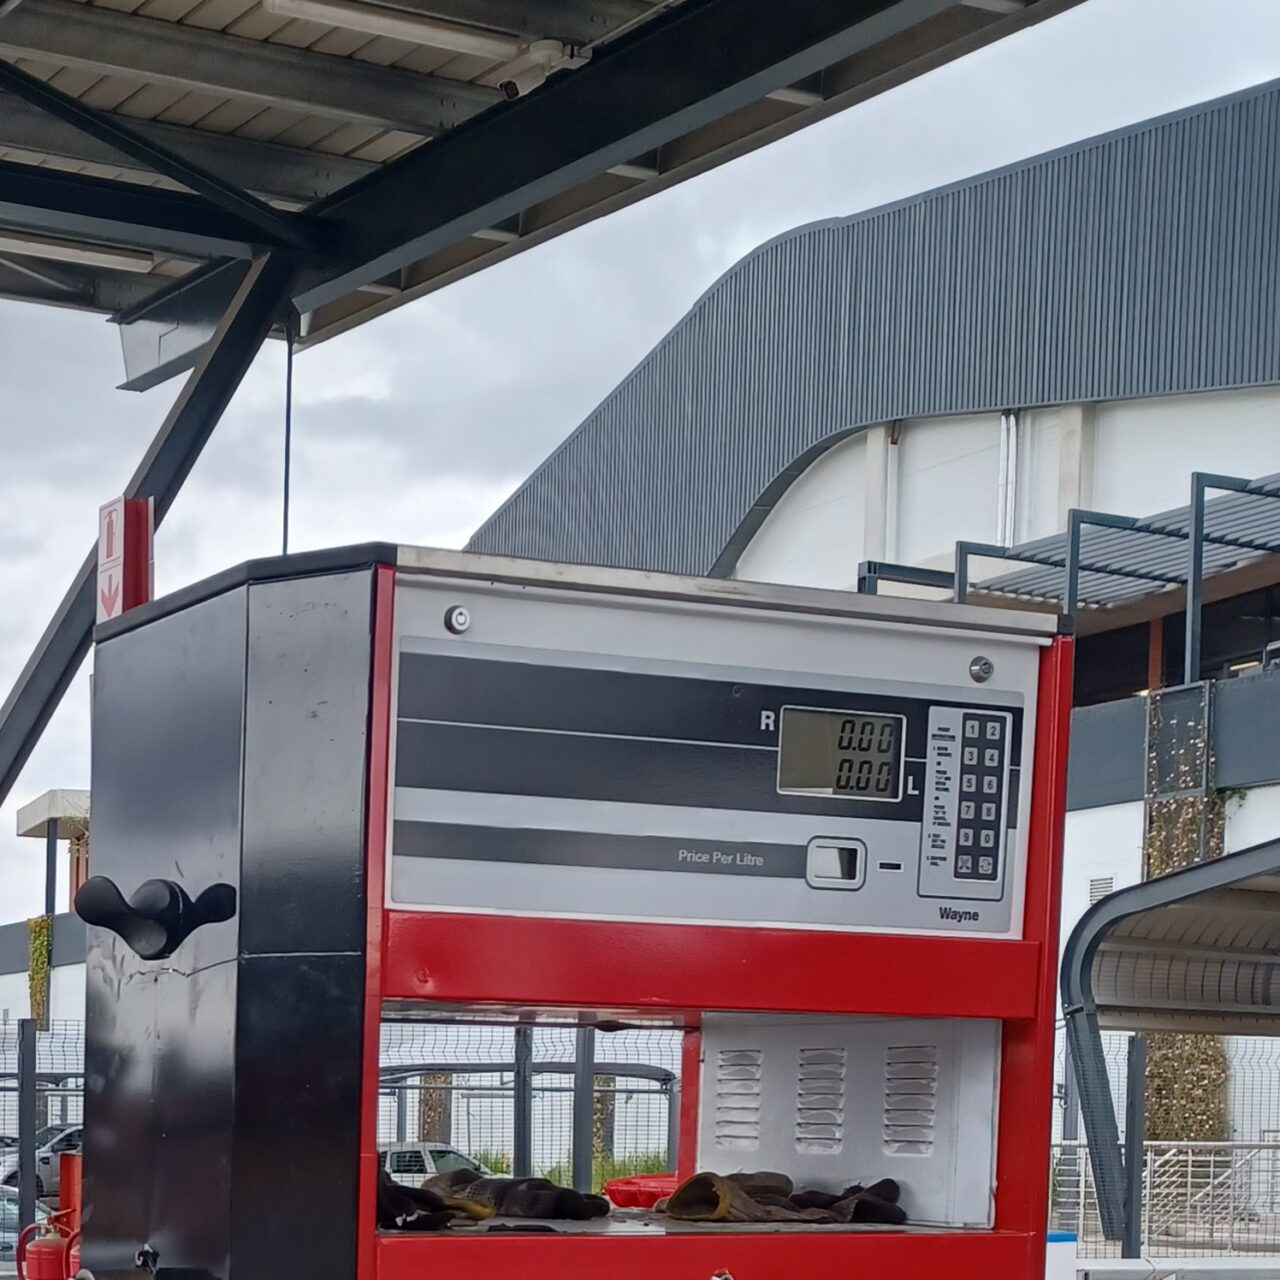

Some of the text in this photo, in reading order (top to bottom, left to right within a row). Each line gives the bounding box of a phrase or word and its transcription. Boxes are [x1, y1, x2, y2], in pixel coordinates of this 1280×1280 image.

[760, 710, 776, 731] R
[837, 719, 894, 754] 0.00
[969, 724, 997, 736] 1 2
[967, 751, 995, 763] 3 4
[835, 758, 892, 793] 0.00
[965, 778, 994, 790] 5 6
[907, 776, 920, 795] L
[964, 805, 971, 816] 7
[962, 832, 991, 844] 9 0
[678, 848, 764, 866] Price Per Litre
[939, 906, 980, 923] Wayne
